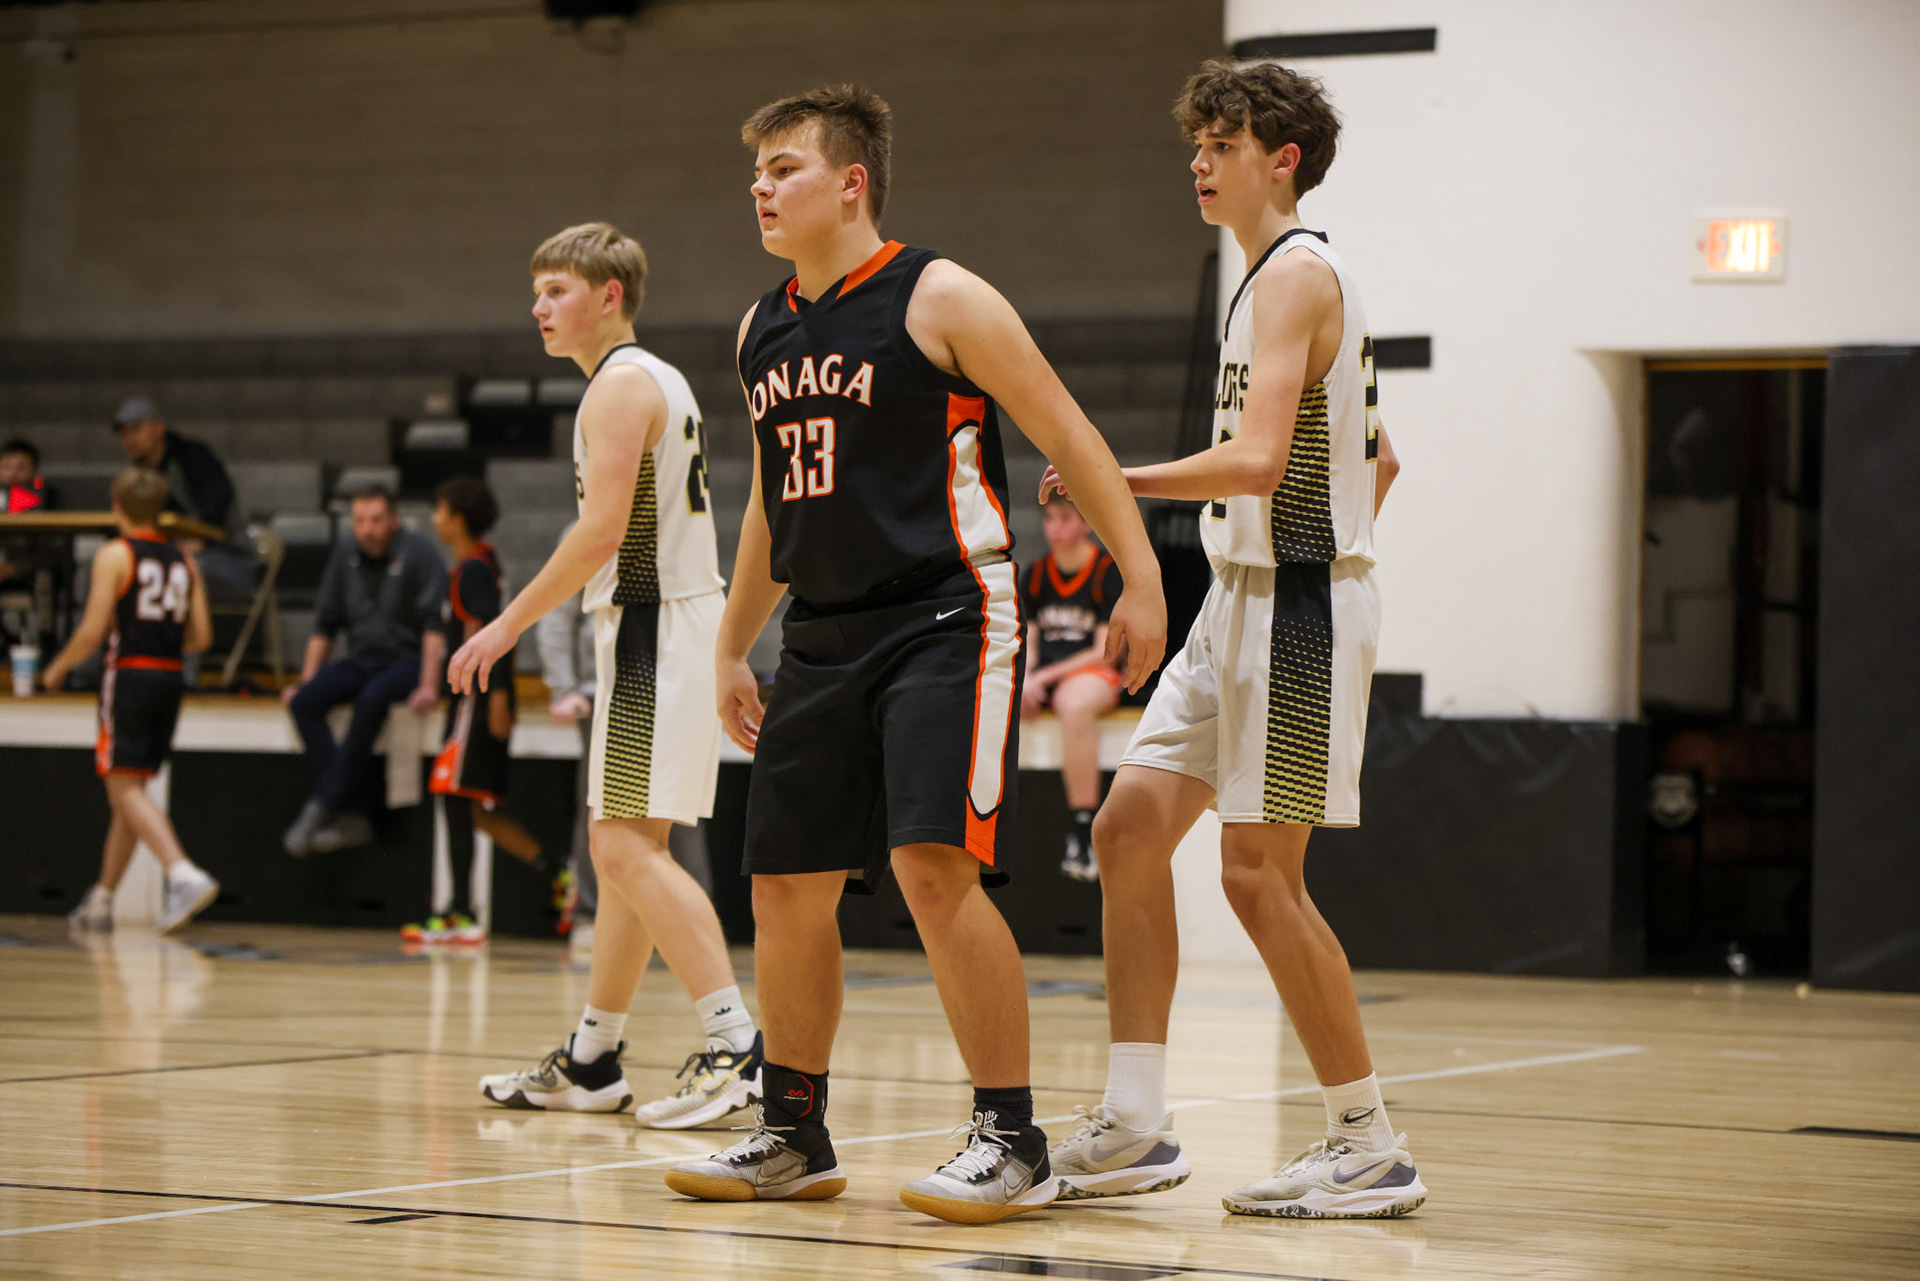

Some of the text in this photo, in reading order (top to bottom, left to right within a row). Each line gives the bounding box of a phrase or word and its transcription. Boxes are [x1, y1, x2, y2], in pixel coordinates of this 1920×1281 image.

[1708, 219, 1776, 273] EXIT
[752, 353, 875, 422] ONAGA
[775, 416, 836, 503] 33
[136, 558, 189, 624] 24
